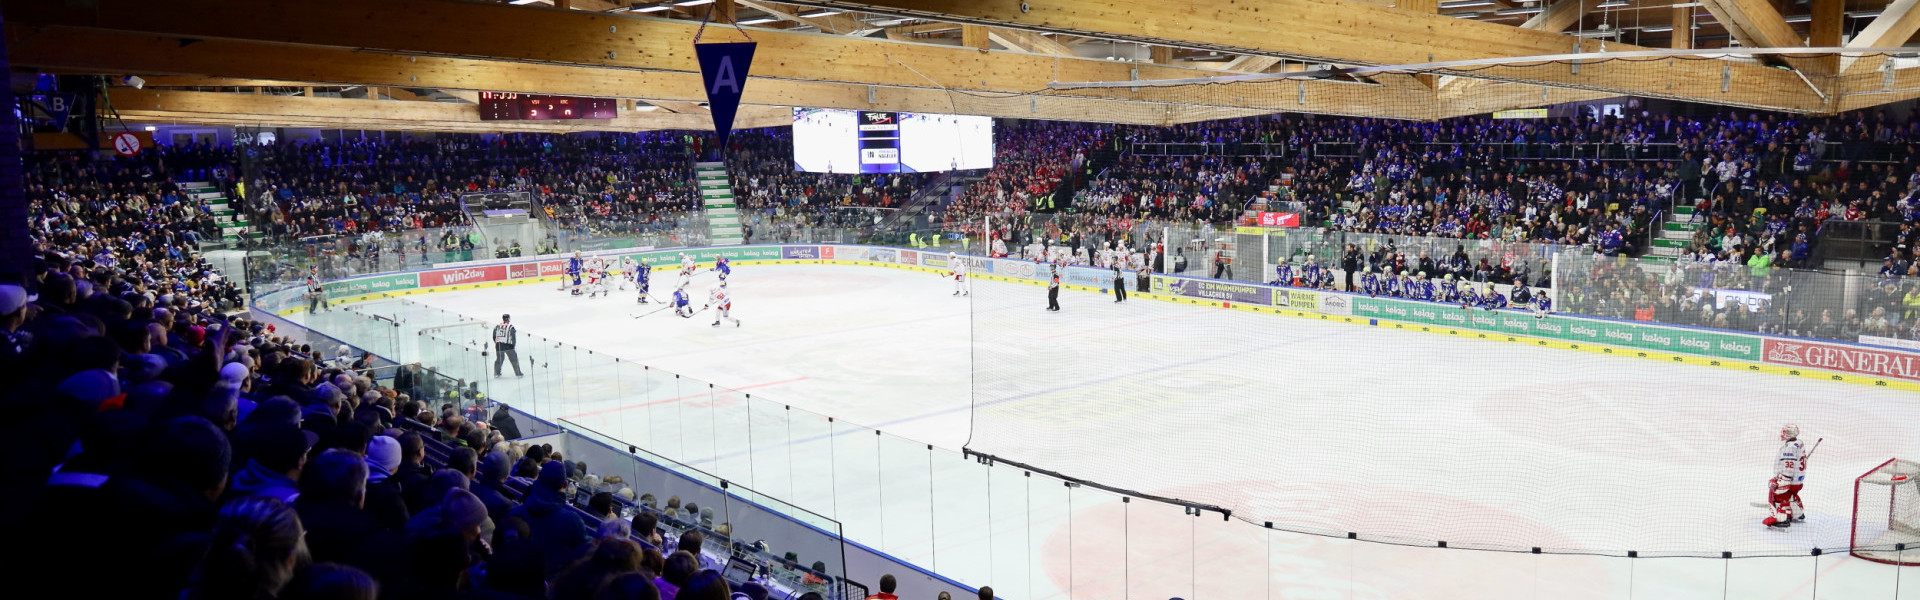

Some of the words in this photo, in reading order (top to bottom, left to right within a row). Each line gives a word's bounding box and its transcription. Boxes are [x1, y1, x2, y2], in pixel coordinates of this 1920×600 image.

[712, 55, 739, 94] A
[1290, 300, 1314, 309] PUMPEN
[1358, 302, 1379, 314] kelag
[1385, 305, 1406, 317] kelag
[1413, 308, 1435, 320] kelag
[1442, 311, 1465, 322] kelag
[1472, 314, 1496, 326] kelag
[1504, 317, 1528, 329] kelag
[1536, 321, 1562, 333] kelag
[1570, 325, 1596, 337] kelag
[1605, 328, 1632, 342] kelag
[1642, 332, 1671, 346] kelag
[1680, 336, 1710, 350] kelag
[1720, 340, 1751, 354] kelag
[1805, 346, 1919, 379] GENERAL
[1799, 456, 1807, 472] 3
